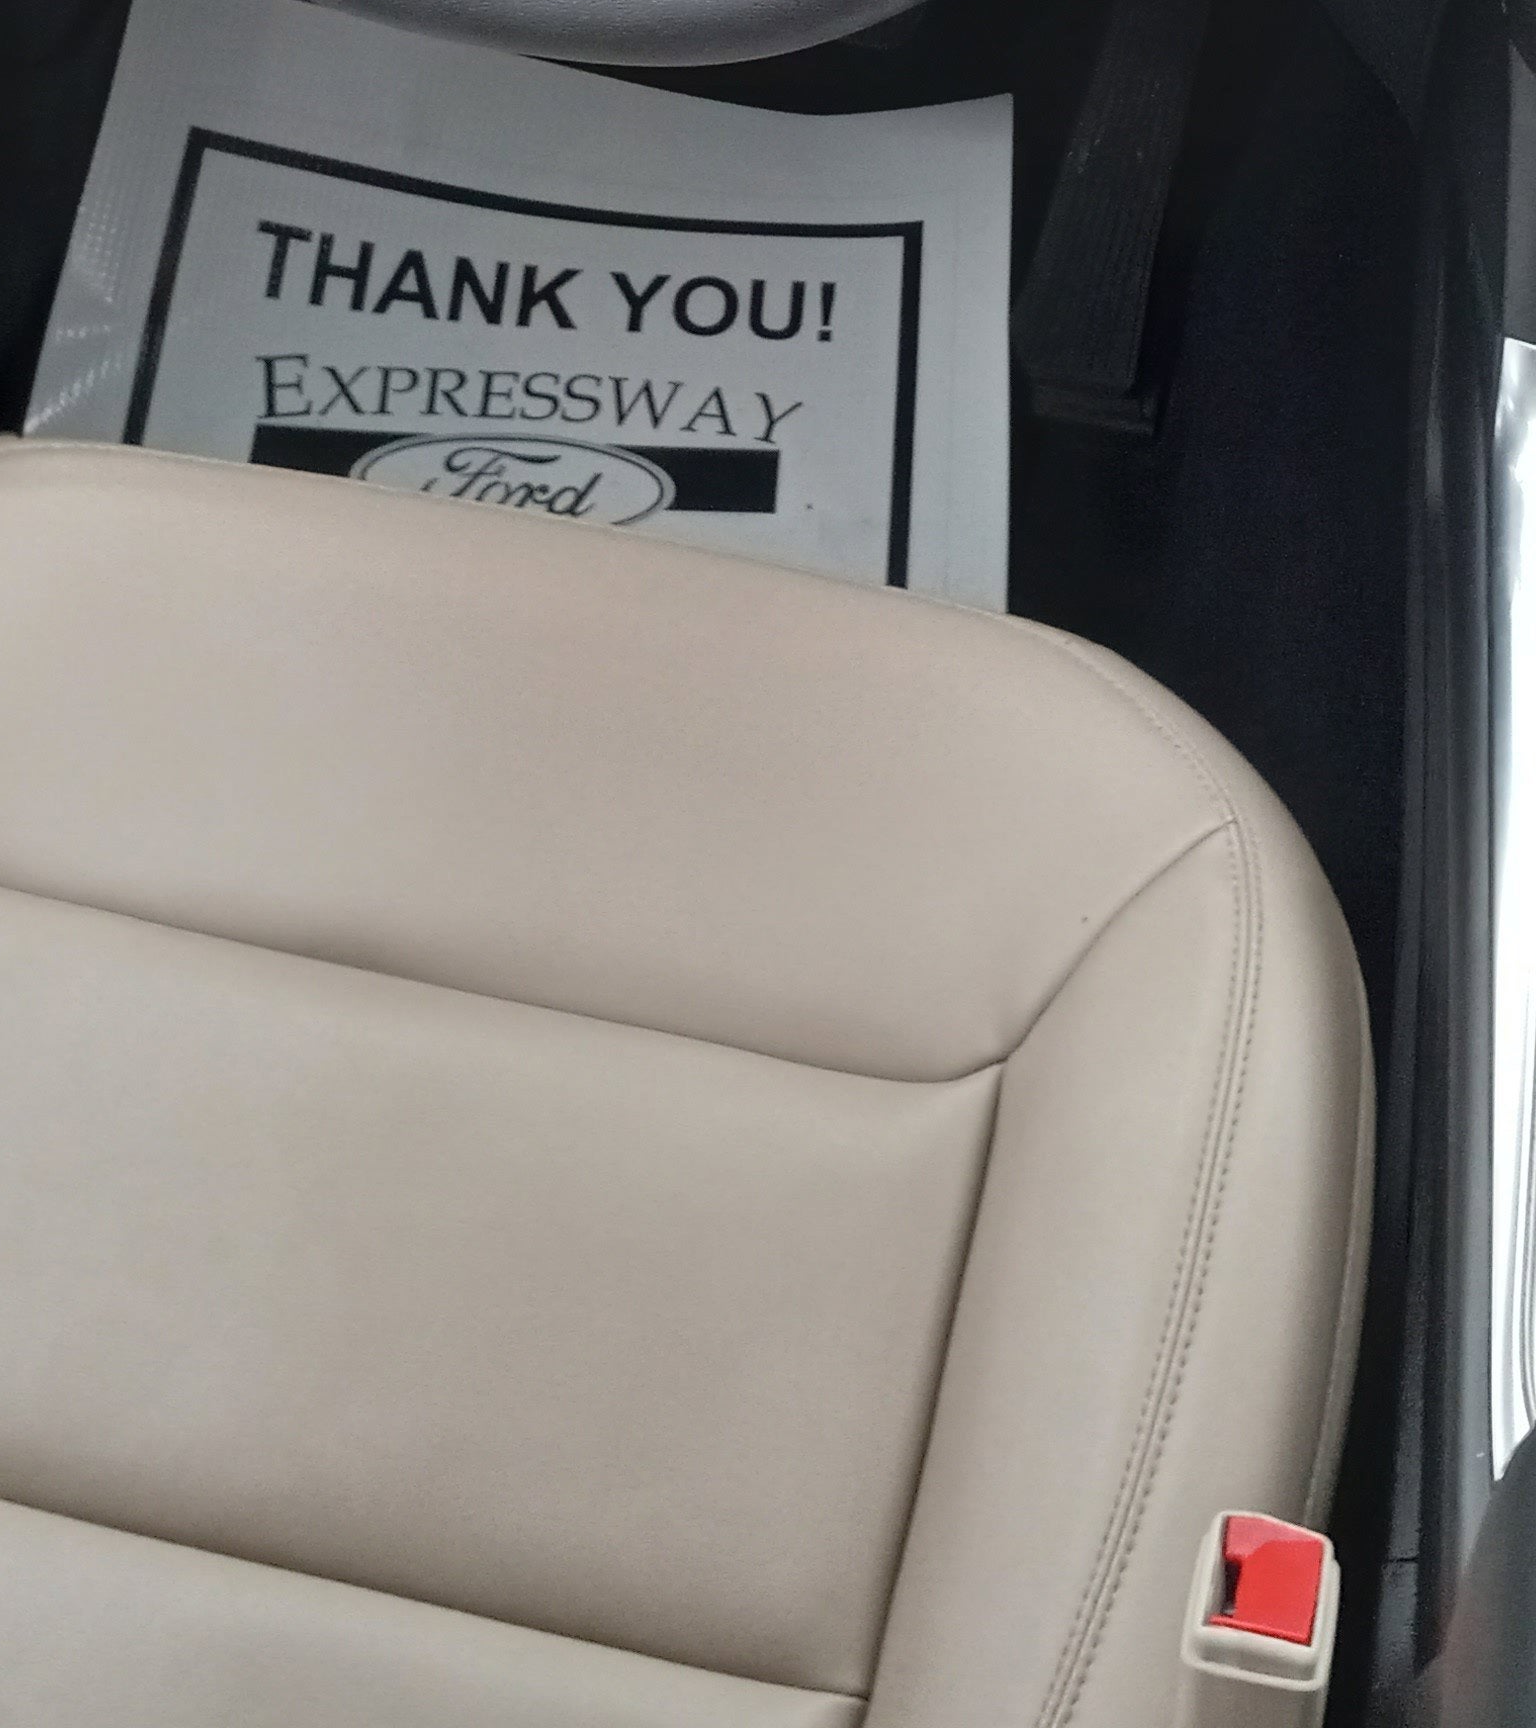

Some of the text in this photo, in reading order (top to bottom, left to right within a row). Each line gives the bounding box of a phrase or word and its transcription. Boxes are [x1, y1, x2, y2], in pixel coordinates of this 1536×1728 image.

[257, 220, 837, 342] THANK YOU!
[254, 353, 803, 447] EXPRESSWAY
[421, 447, 604, 517] Ford
